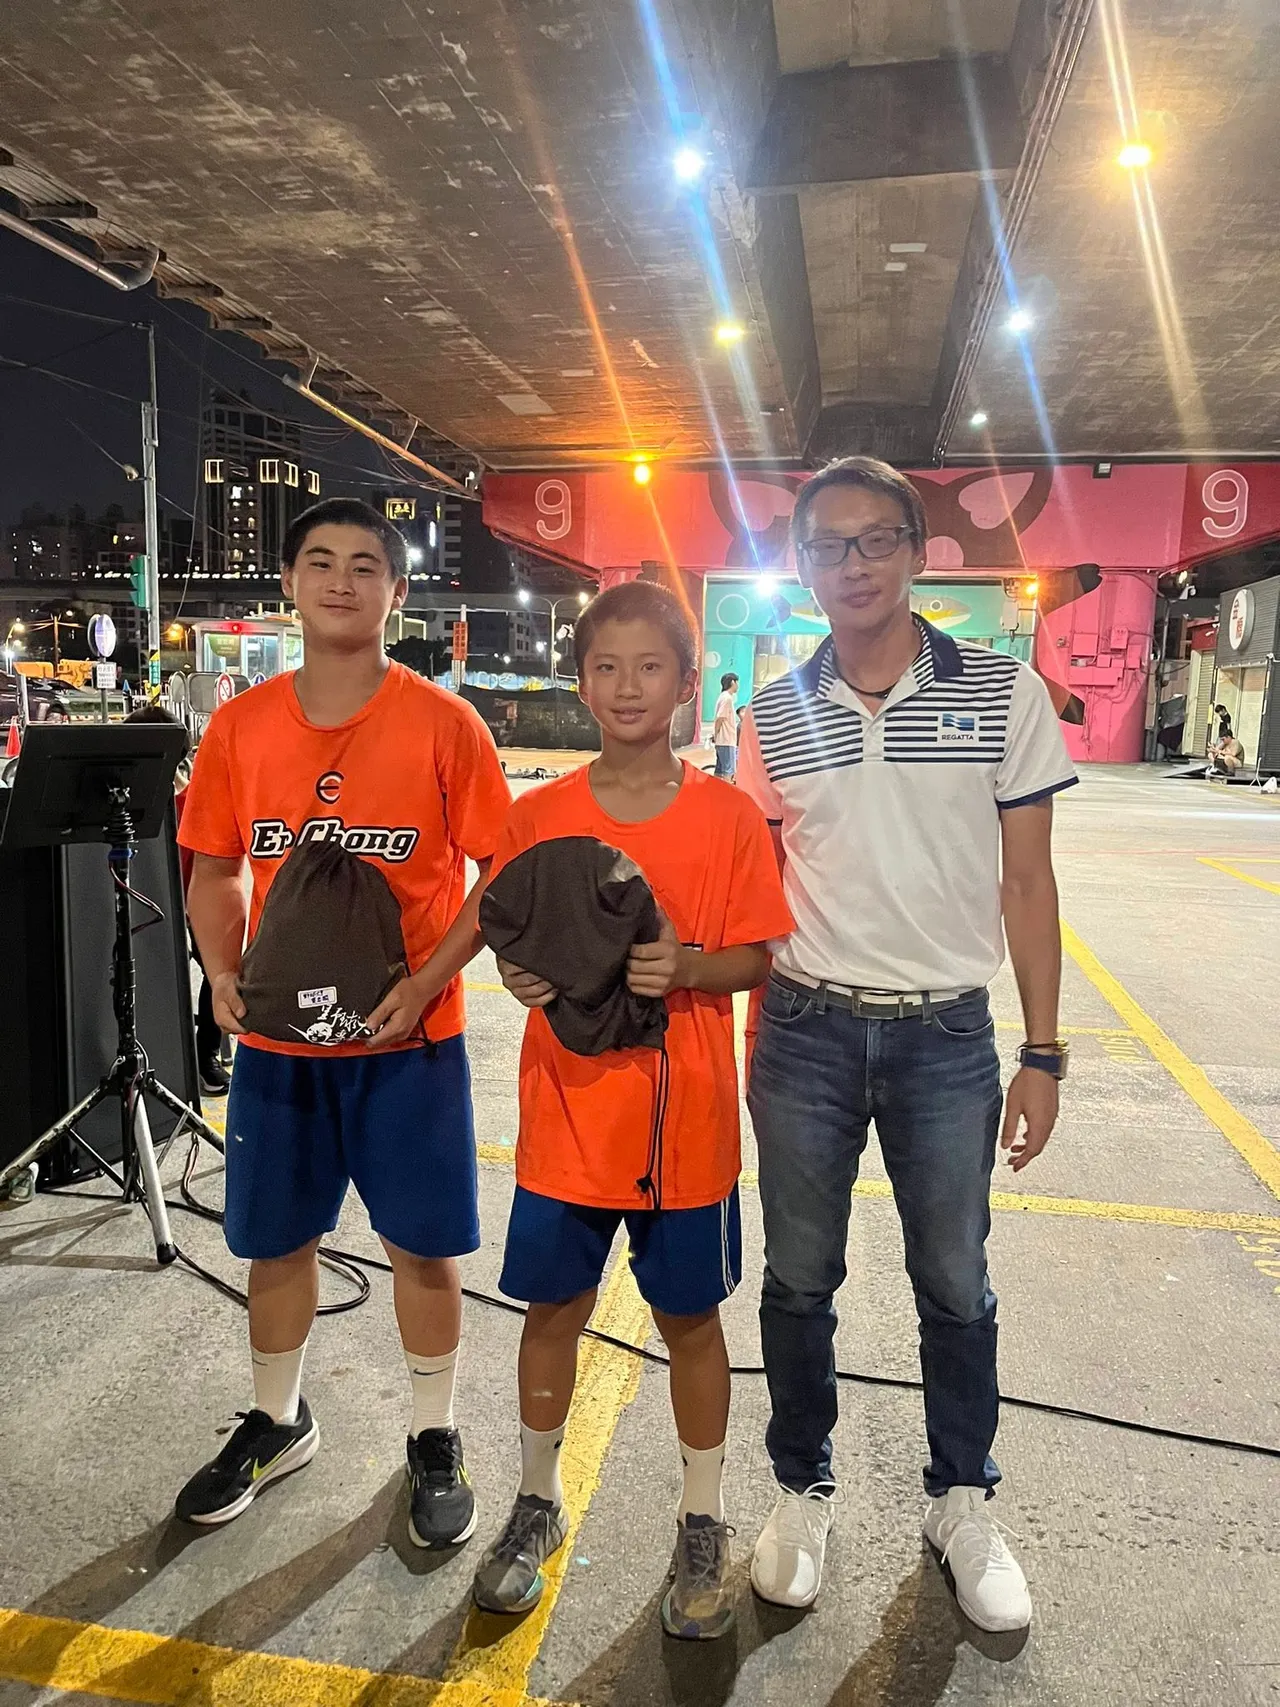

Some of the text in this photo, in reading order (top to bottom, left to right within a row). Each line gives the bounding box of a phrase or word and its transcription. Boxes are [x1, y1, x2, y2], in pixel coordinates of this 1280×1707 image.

[534, 479, 573, 540] 9
[1201, 469, 1249, 538] 9
[251, 816, 420, 863] Er Chong
